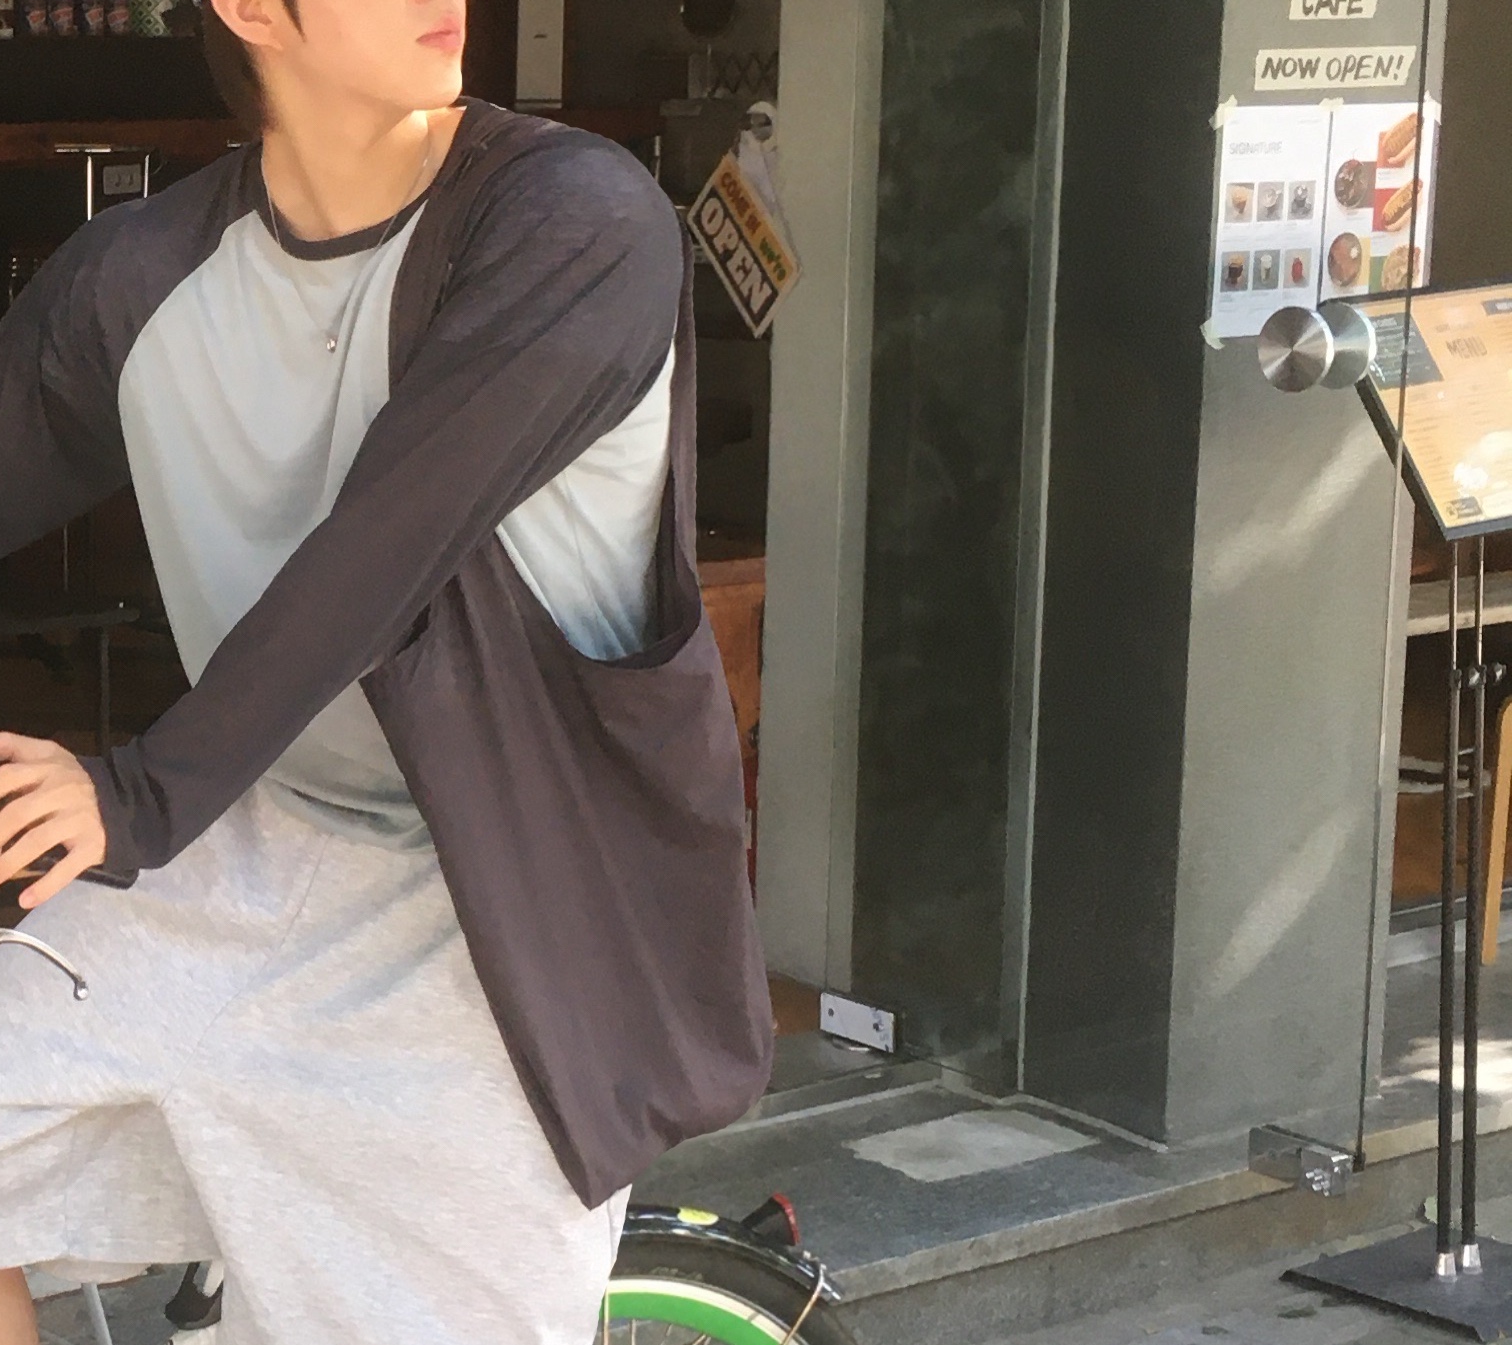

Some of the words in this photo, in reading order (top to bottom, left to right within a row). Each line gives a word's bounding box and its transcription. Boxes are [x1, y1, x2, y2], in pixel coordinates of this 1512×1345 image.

[1261, 56, 1321, 80] NOW
[1326, 54, 1404, 82] OPEN!
[1228, 141, 1283, 155] SIGNATURE
[700, 197, 774, 313] OPEN
[1445, 336, 1488, 359] MENU
